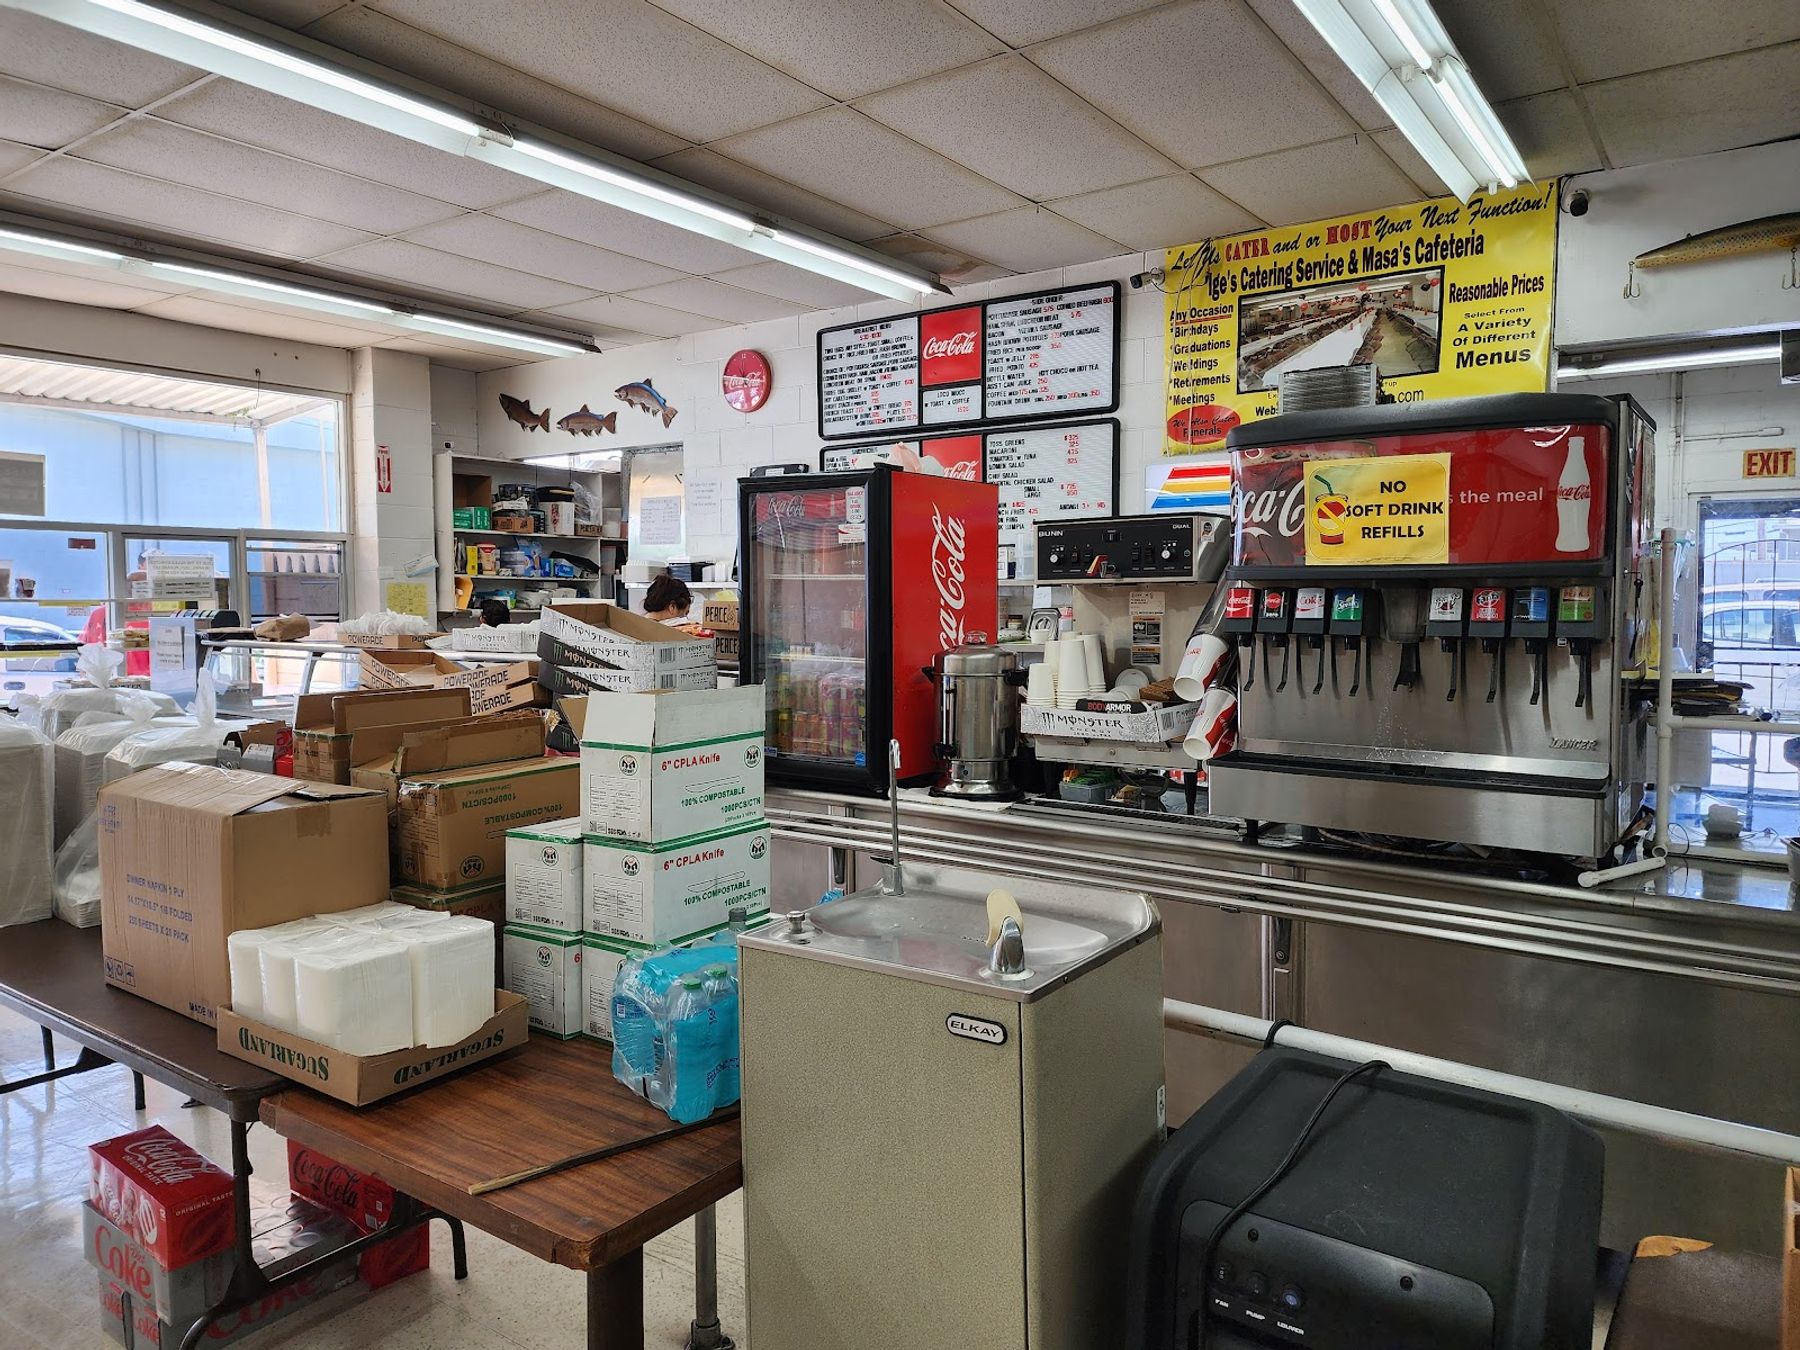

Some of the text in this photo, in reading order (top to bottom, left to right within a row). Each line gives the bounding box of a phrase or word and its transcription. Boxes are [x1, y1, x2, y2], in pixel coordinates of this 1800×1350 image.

[1225, 238, 1270, 262] CATER
[1273, 232, 1302, 254] and
[1306, 235, 1321, 249] or
[1326, 218, 1373, 245] HOST
[1374, 215, 1412, 242] Your
[1420, 204, 1460, 228] Next
[1468, 182, 1554, 225] Function!
[1208, 228, 1484, 301] Ige's Catering Service & Masa's Cafeteria
[1449, 274, 1544, 303] Reasonable Prices
[1170, 304, 1234, 323] Any Occasion
[1464, 306, 1525, 319] Select From
[1458, 317, 1532, 333] A Variety
[923, 332, 978, 360] Coca-Cola
[1452, 330, 1536, 347] Of Different
[1456, 348, 1531, 369] Menus
[1173, 392, 1216, 406] Meetings
[1746, 450, 1794, 477] EXIT
[1380, 480, 1407, 494] NO
[1460, 488, 1543, 504] the meal
[1346, 501, 1444, 518] SOFT DRINK
[1361, 524, 1425, 539] REFILLS
[705, 606, 728, 623] PEACE
[348, 634, 384, 645] POWERADE
[716, 638, 738, 654] PEACE
[472, 692, 512, 714] OWERADE
[1087, 701, 1132, 713] BODYARMOR
[1057, 714, 1124, 729] MONSTER
[662, 753, 721, 771] 6" CPLA Knife
[681, 786, 746, 808] 100% COMPOSTABLE
[484, 808, 543, 825] COMPOSTABLE
[663, 848, 725, 871] 6" CPLA Knife
[174, 886, 185, 898] PLY
[684, 880, 751, 906] 100% COMPOSTABLE
[169, 907, 193, 922] FOLDED
[173, 930, 189, 944] PACK
[188, 1002, 214, 1019] MADE IN
[950, 1020, 1001, 1039] ELKAY
[238, 1027, 330, 1082] SUGARLAND
[394, 1028, 505, 1085] SUGARLAND
[292, 1150, 360, 1209] Coca-Cola
[176, 1200, 211, 1217] ORIGINAL
[1215, 1298, 1229, 1308] FAN
